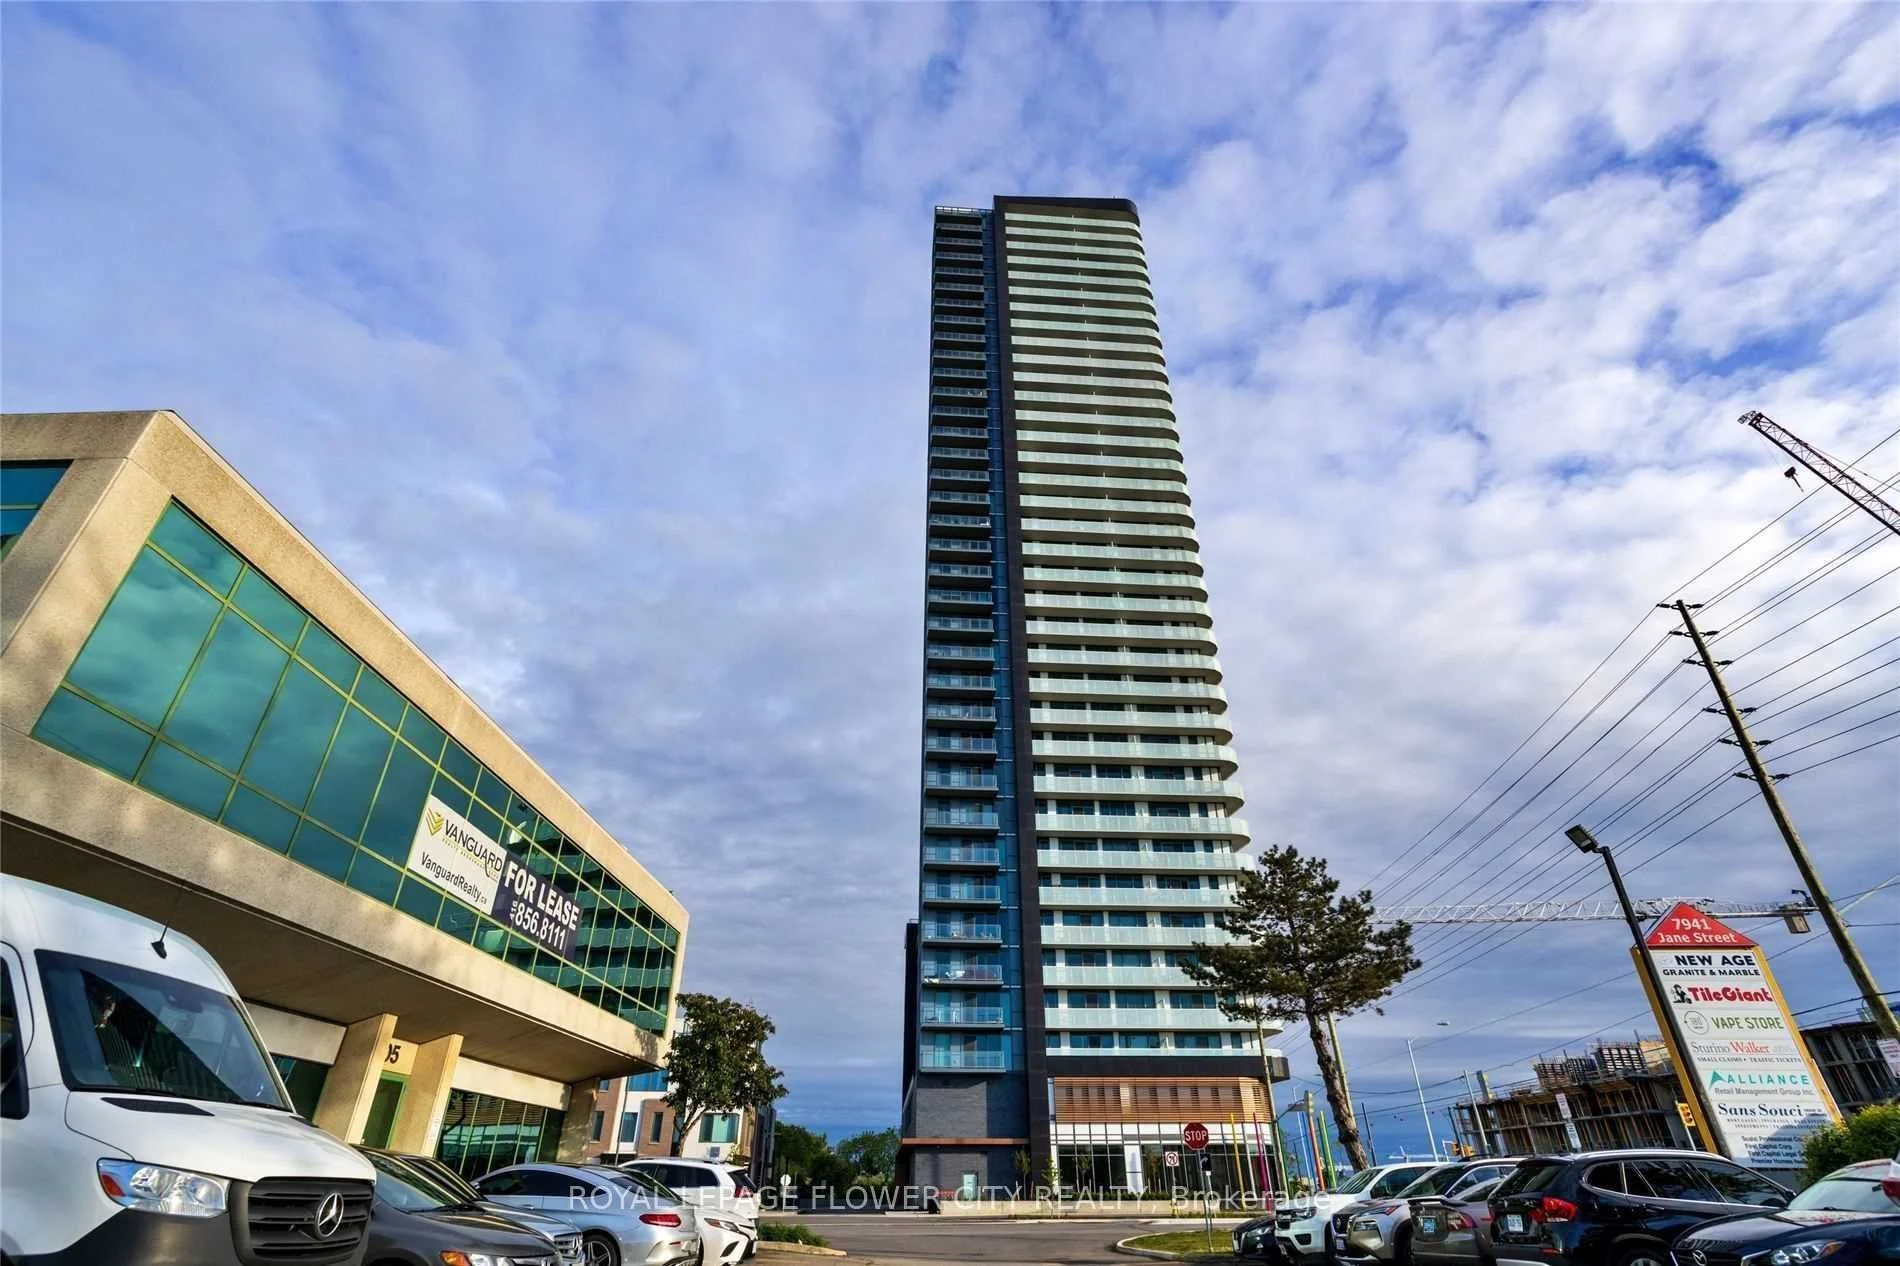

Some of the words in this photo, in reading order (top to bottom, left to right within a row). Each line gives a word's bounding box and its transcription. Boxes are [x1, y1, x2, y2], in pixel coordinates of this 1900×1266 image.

[445, 819, 503, 878] VANGUARD
[504, 860, 537, 904] FOR
[537, 882, 580, 931] LEASE
[515, 902, 566, 951] 856.8111
[1671, 918, 1712, 931] 7941
[1657, 932, 1690, 943] Jane
[1693, 932, 1737, 943] Street
[1674, 955, 1713, 966] NEW
[1721, 955, 1756, 966] AGE
[1662, 968, 1706, 977] GRANITE
[1709, 968, 1717, 977] &
[1719, 968, 1761, 977] MARBLE
[1687, 986, 1774, 1002] TileGiant
[1711, 1017, 1744, 1029] VAPE
[1744, 1017, 1784, 1029] STORE
[1730, 1041, 1770, 1054] Walker
[1727, 1074, 1809, 1085] ALLIANCE
[1714, 1087, 1734, 1095] Retail
[1735, 1087, 1777, 1097] Management
[1718, 1102, 1756, 1116] Sans
[1758, 1102, 1802, 1116] Souci
[1185, 1130, 1207, 1141] STOP
